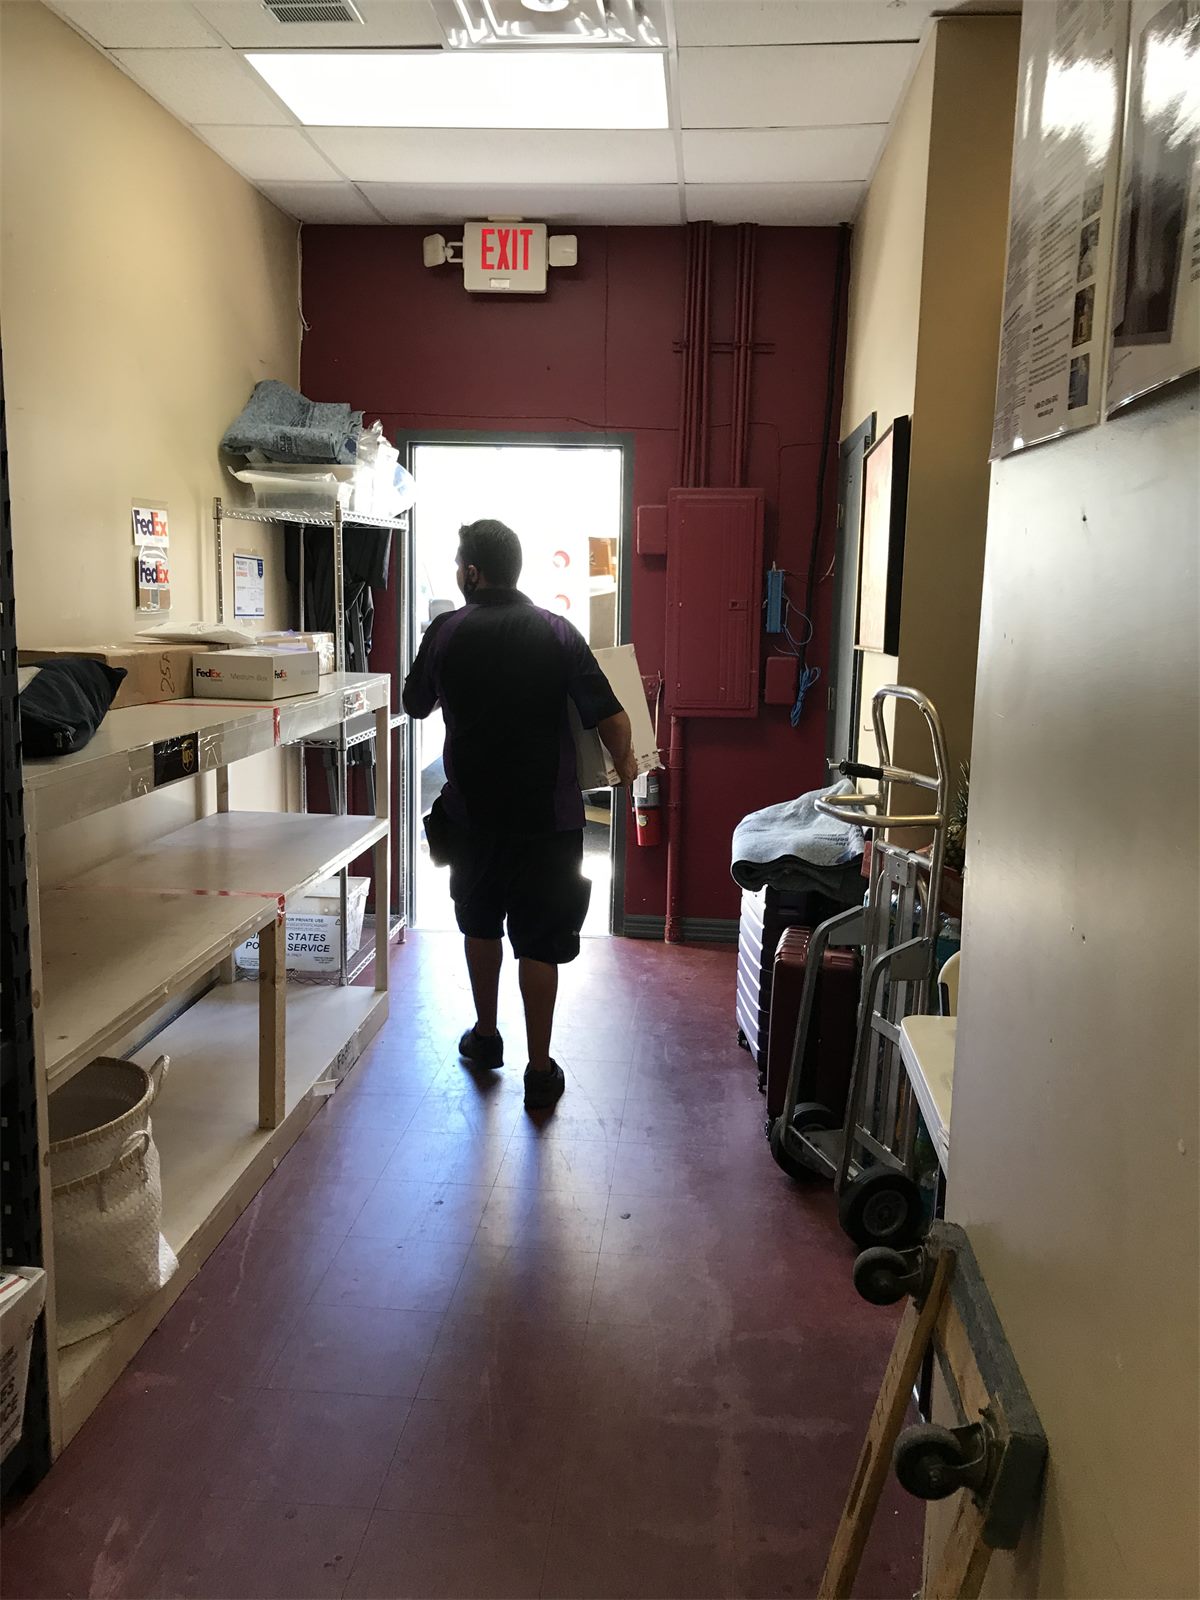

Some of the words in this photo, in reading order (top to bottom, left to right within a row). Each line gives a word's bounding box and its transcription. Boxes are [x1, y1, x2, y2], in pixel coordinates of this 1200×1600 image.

[481, 229, 533, 270] EXIT
[134, 509, 168, 537] FedEx
[140, 560, 169, 584] FedEx
[196, 668, 221, 679] FedEx
[274, 670, 288, 679] FedEx
[288, 932, 326, 942] STATES
[287, 943, 330, 953] SERVICE
